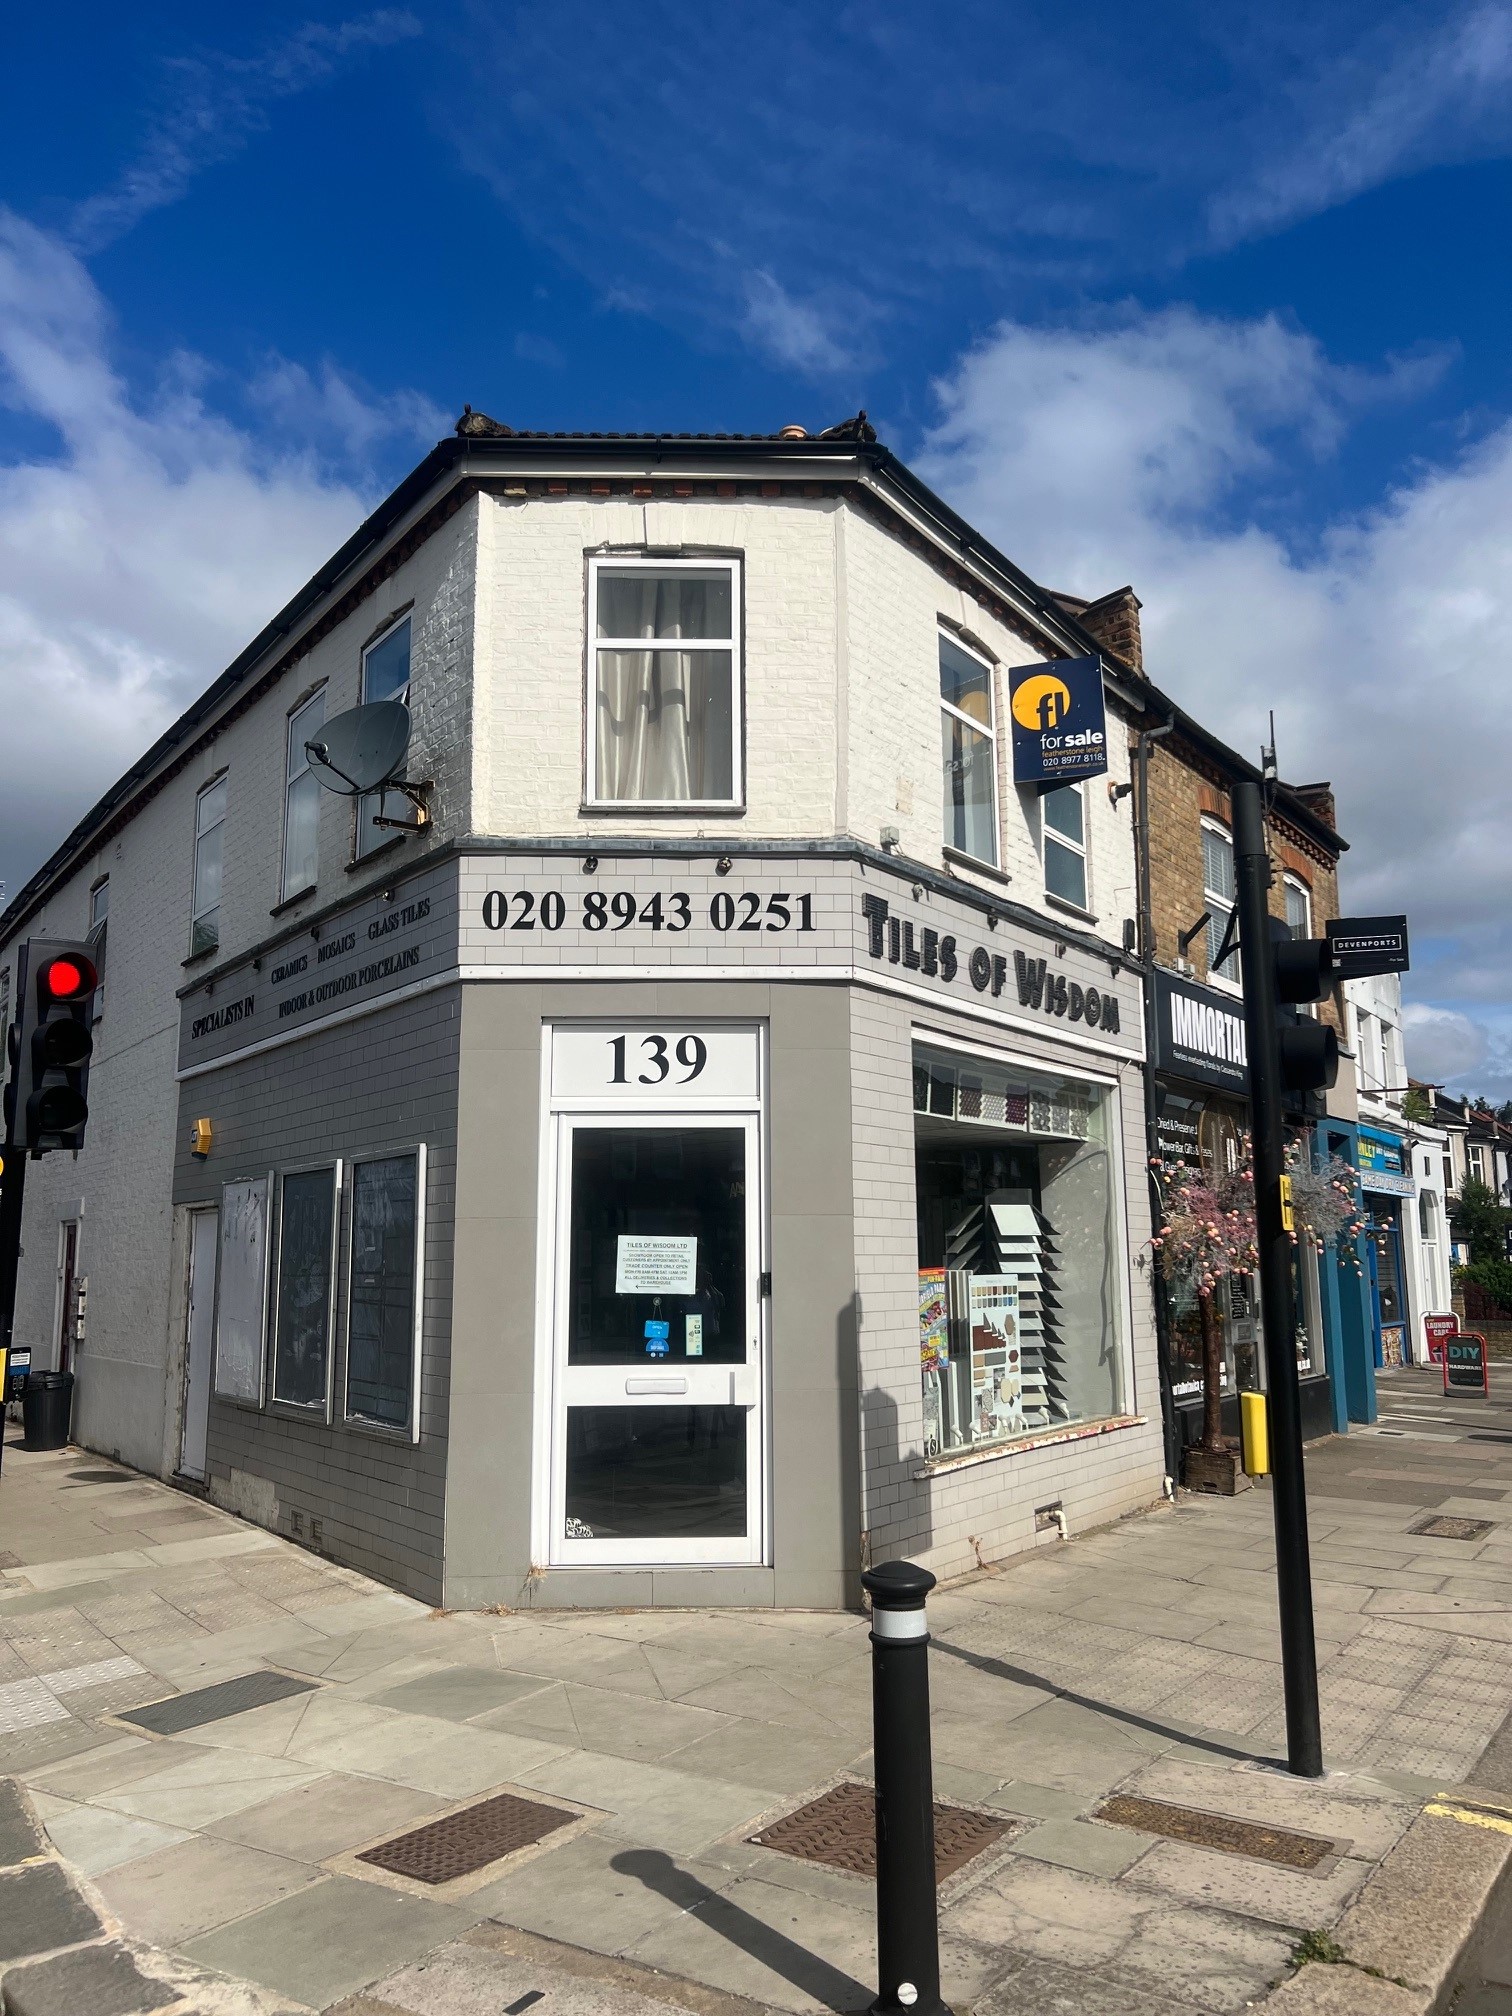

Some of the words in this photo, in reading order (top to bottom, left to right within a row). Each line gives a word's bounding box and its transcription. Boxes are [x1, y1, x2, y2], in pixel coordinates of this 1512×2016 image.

[1040, 733, 1063, 750] for
[1065, 728, 1103, 747] sale
[1042, 748, 1085, 758] featherstone
[1043, 757, 1059, 767] 020
[1061, 755, 1081, 765] 8977
[482, 890, 566, 932] 020
[583, 891, 692, 932] 8943
[709, 891, 817, 932] 0251
[271, 954, 308, 985] CERAMICS
[317, 932, 356, 964] MOSAICS
[367, 911, 399, 940] GLASS
[400, 898, 430, 927] TILES
[1337, 939, 1397, 949] DEVENPORTS
[862, 892, 958, 983] TILES
[968, 946, 1007, 998] OF
[1013, 949, 1121, 1035] WISDOM
[279, 993, 307, 1018] INDOOR
[308, 991, 315, 1006] &
[316, 977, 357, 1003] OUTDOOR
[359, 946, 420, 985] PORCELAINS
[192, 998, 244, 1040] SPECIALISTS
[244, 995, 255, 1016] IN
[1170, 991, 1248, 1067] IMMORTAL
[606, 1034, 707, 1085] 139
[1362, 1172, 1376, 1188] SAME
[1426, 1321, 1454, 1330] LAUNDRY
[1448, 1345, 1480, 1360] DIY
